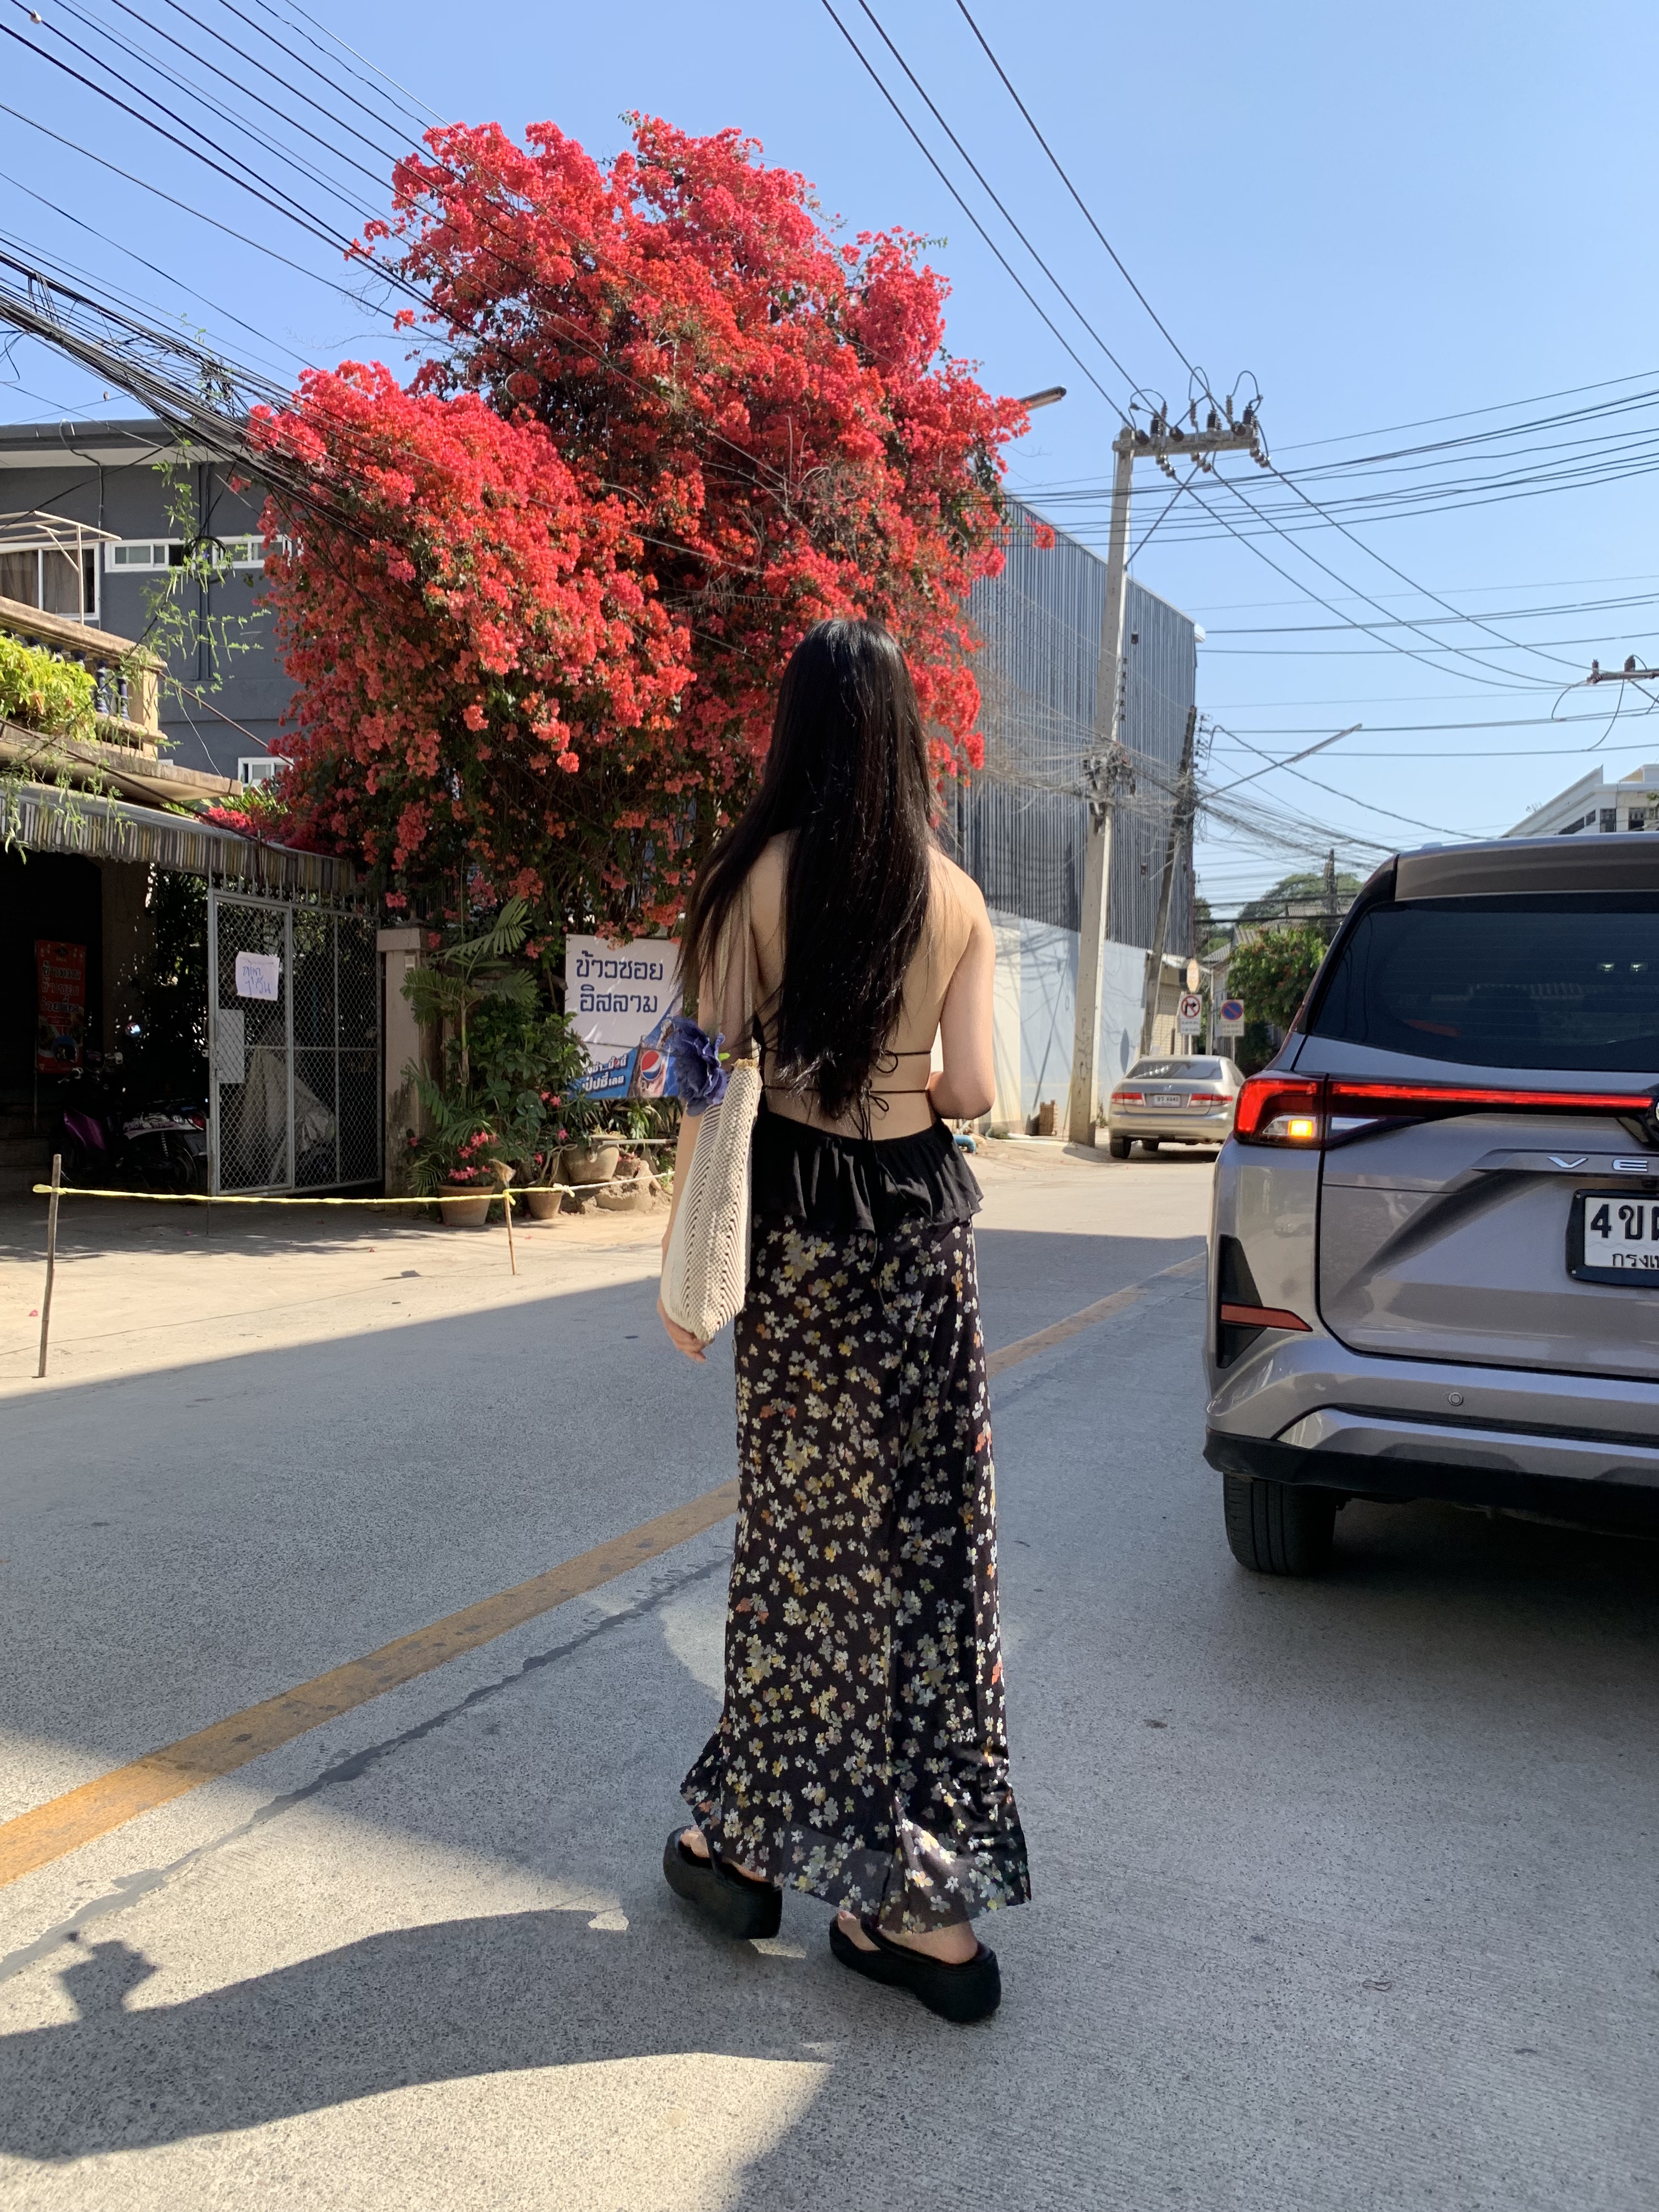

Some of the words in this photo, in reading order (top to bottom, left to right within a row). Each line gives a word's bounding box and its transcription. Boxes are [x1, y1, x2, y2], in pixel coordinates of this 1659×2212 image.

[576, 950, 663, 980] ข้าวซอย
[580, 984, 658, 1012] อิสลาม
